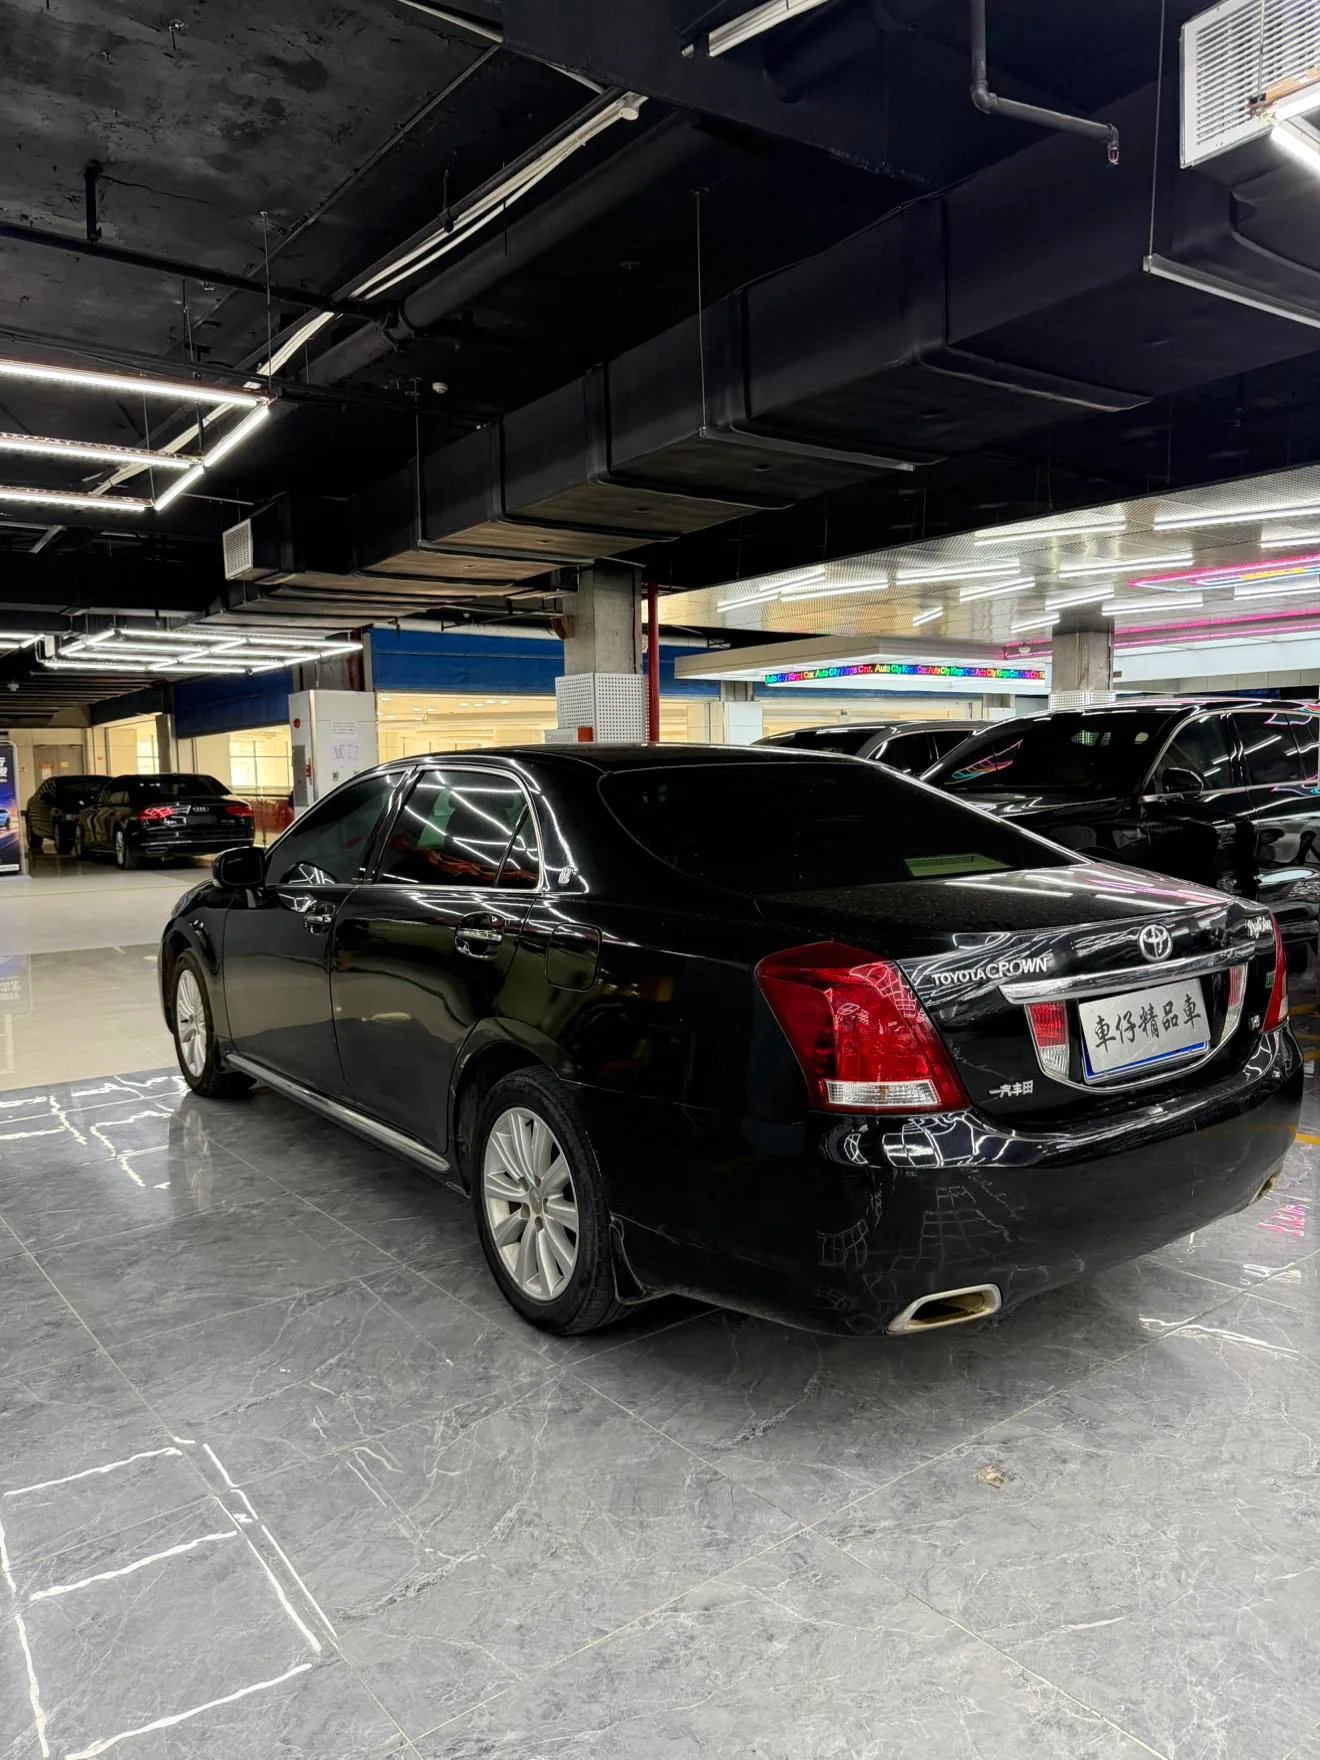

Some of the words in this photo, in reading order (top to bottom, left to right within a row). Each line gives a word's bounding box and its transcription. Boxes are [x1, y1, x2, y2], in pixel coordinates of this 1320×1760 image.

[874, 664, 890, 673] Auto
[891, 665, 902, 674] City
[931, 968, 987, 986] TOYOTA
[985, 958, 1047, 979] CROWN
[1094, 993, 1201, 1053] 車仔精品車
[989, 1080, 1034, 1098] 一汽丰田
